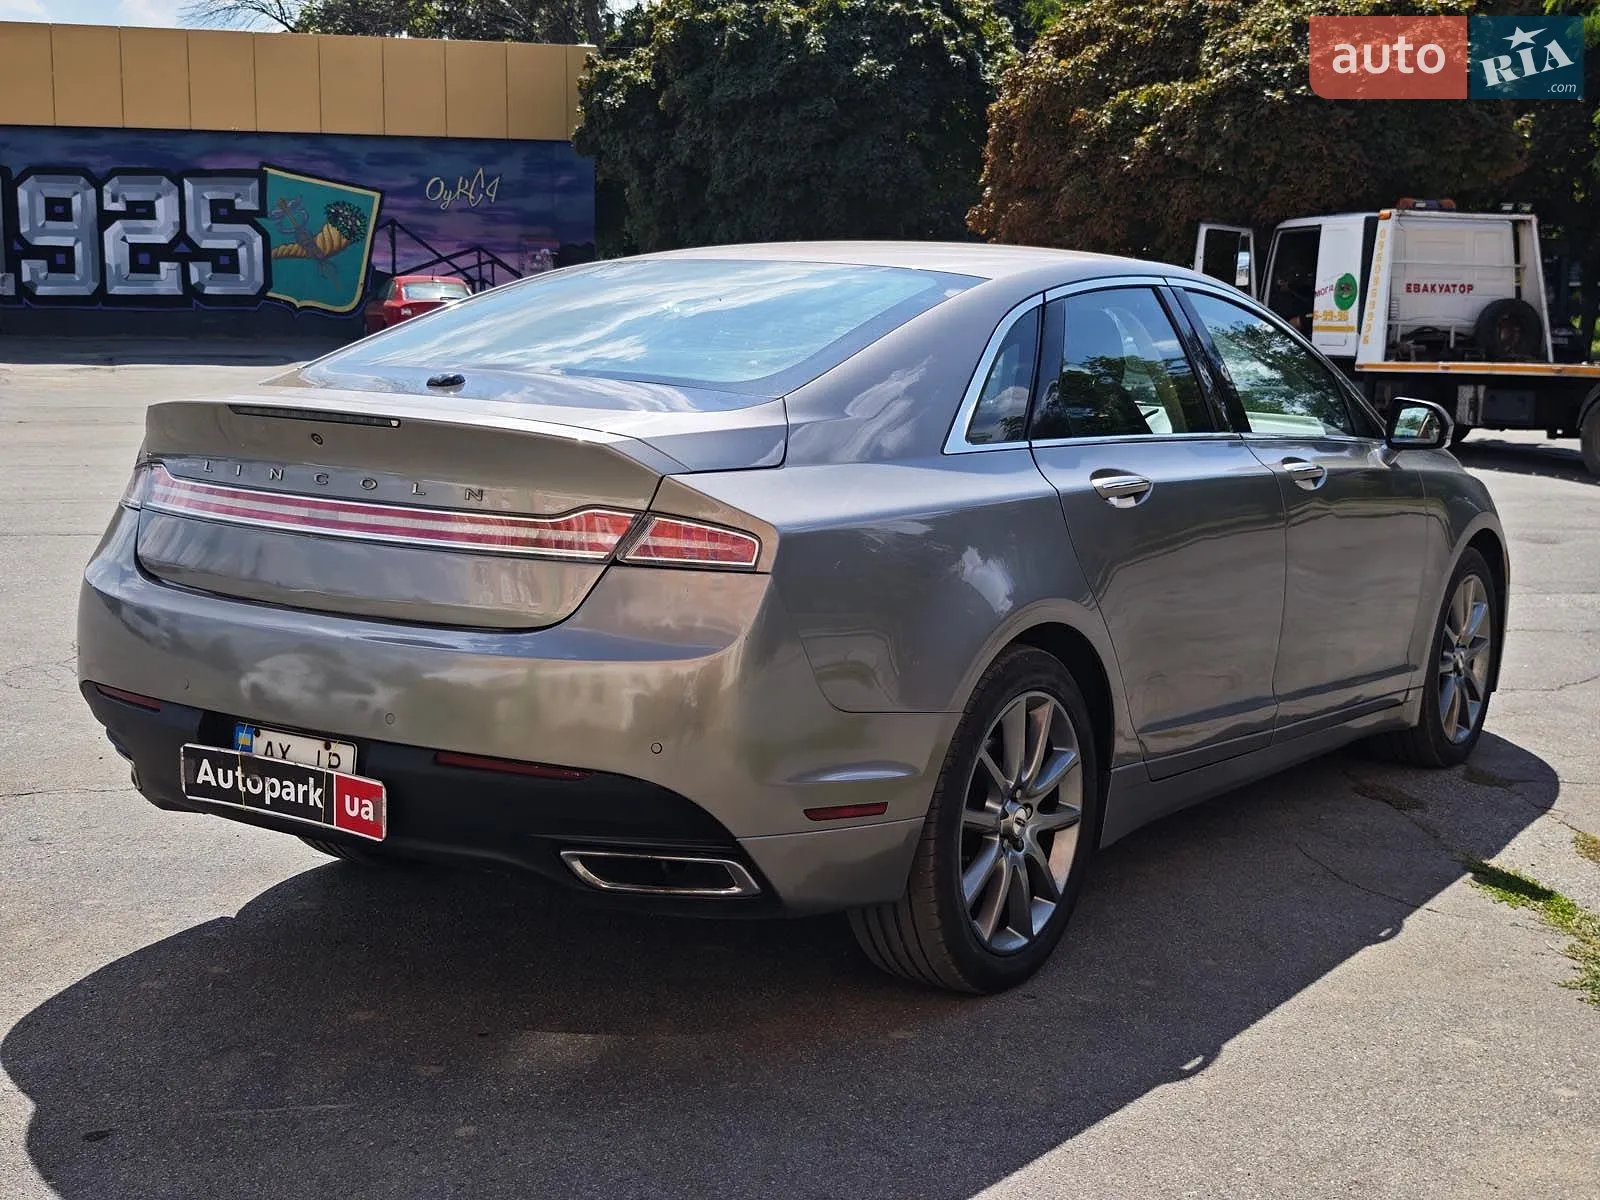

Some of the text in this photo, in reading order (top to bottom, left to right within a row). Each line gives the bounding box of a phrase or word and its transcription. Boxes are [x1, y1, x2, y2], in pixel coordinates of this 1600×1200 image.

[1405, 283, 1475, 295] ЕВАКУАТОР
[203, 460, 485, 502] LINCOLN
[196, 758, 375, 822] Autopark ua
